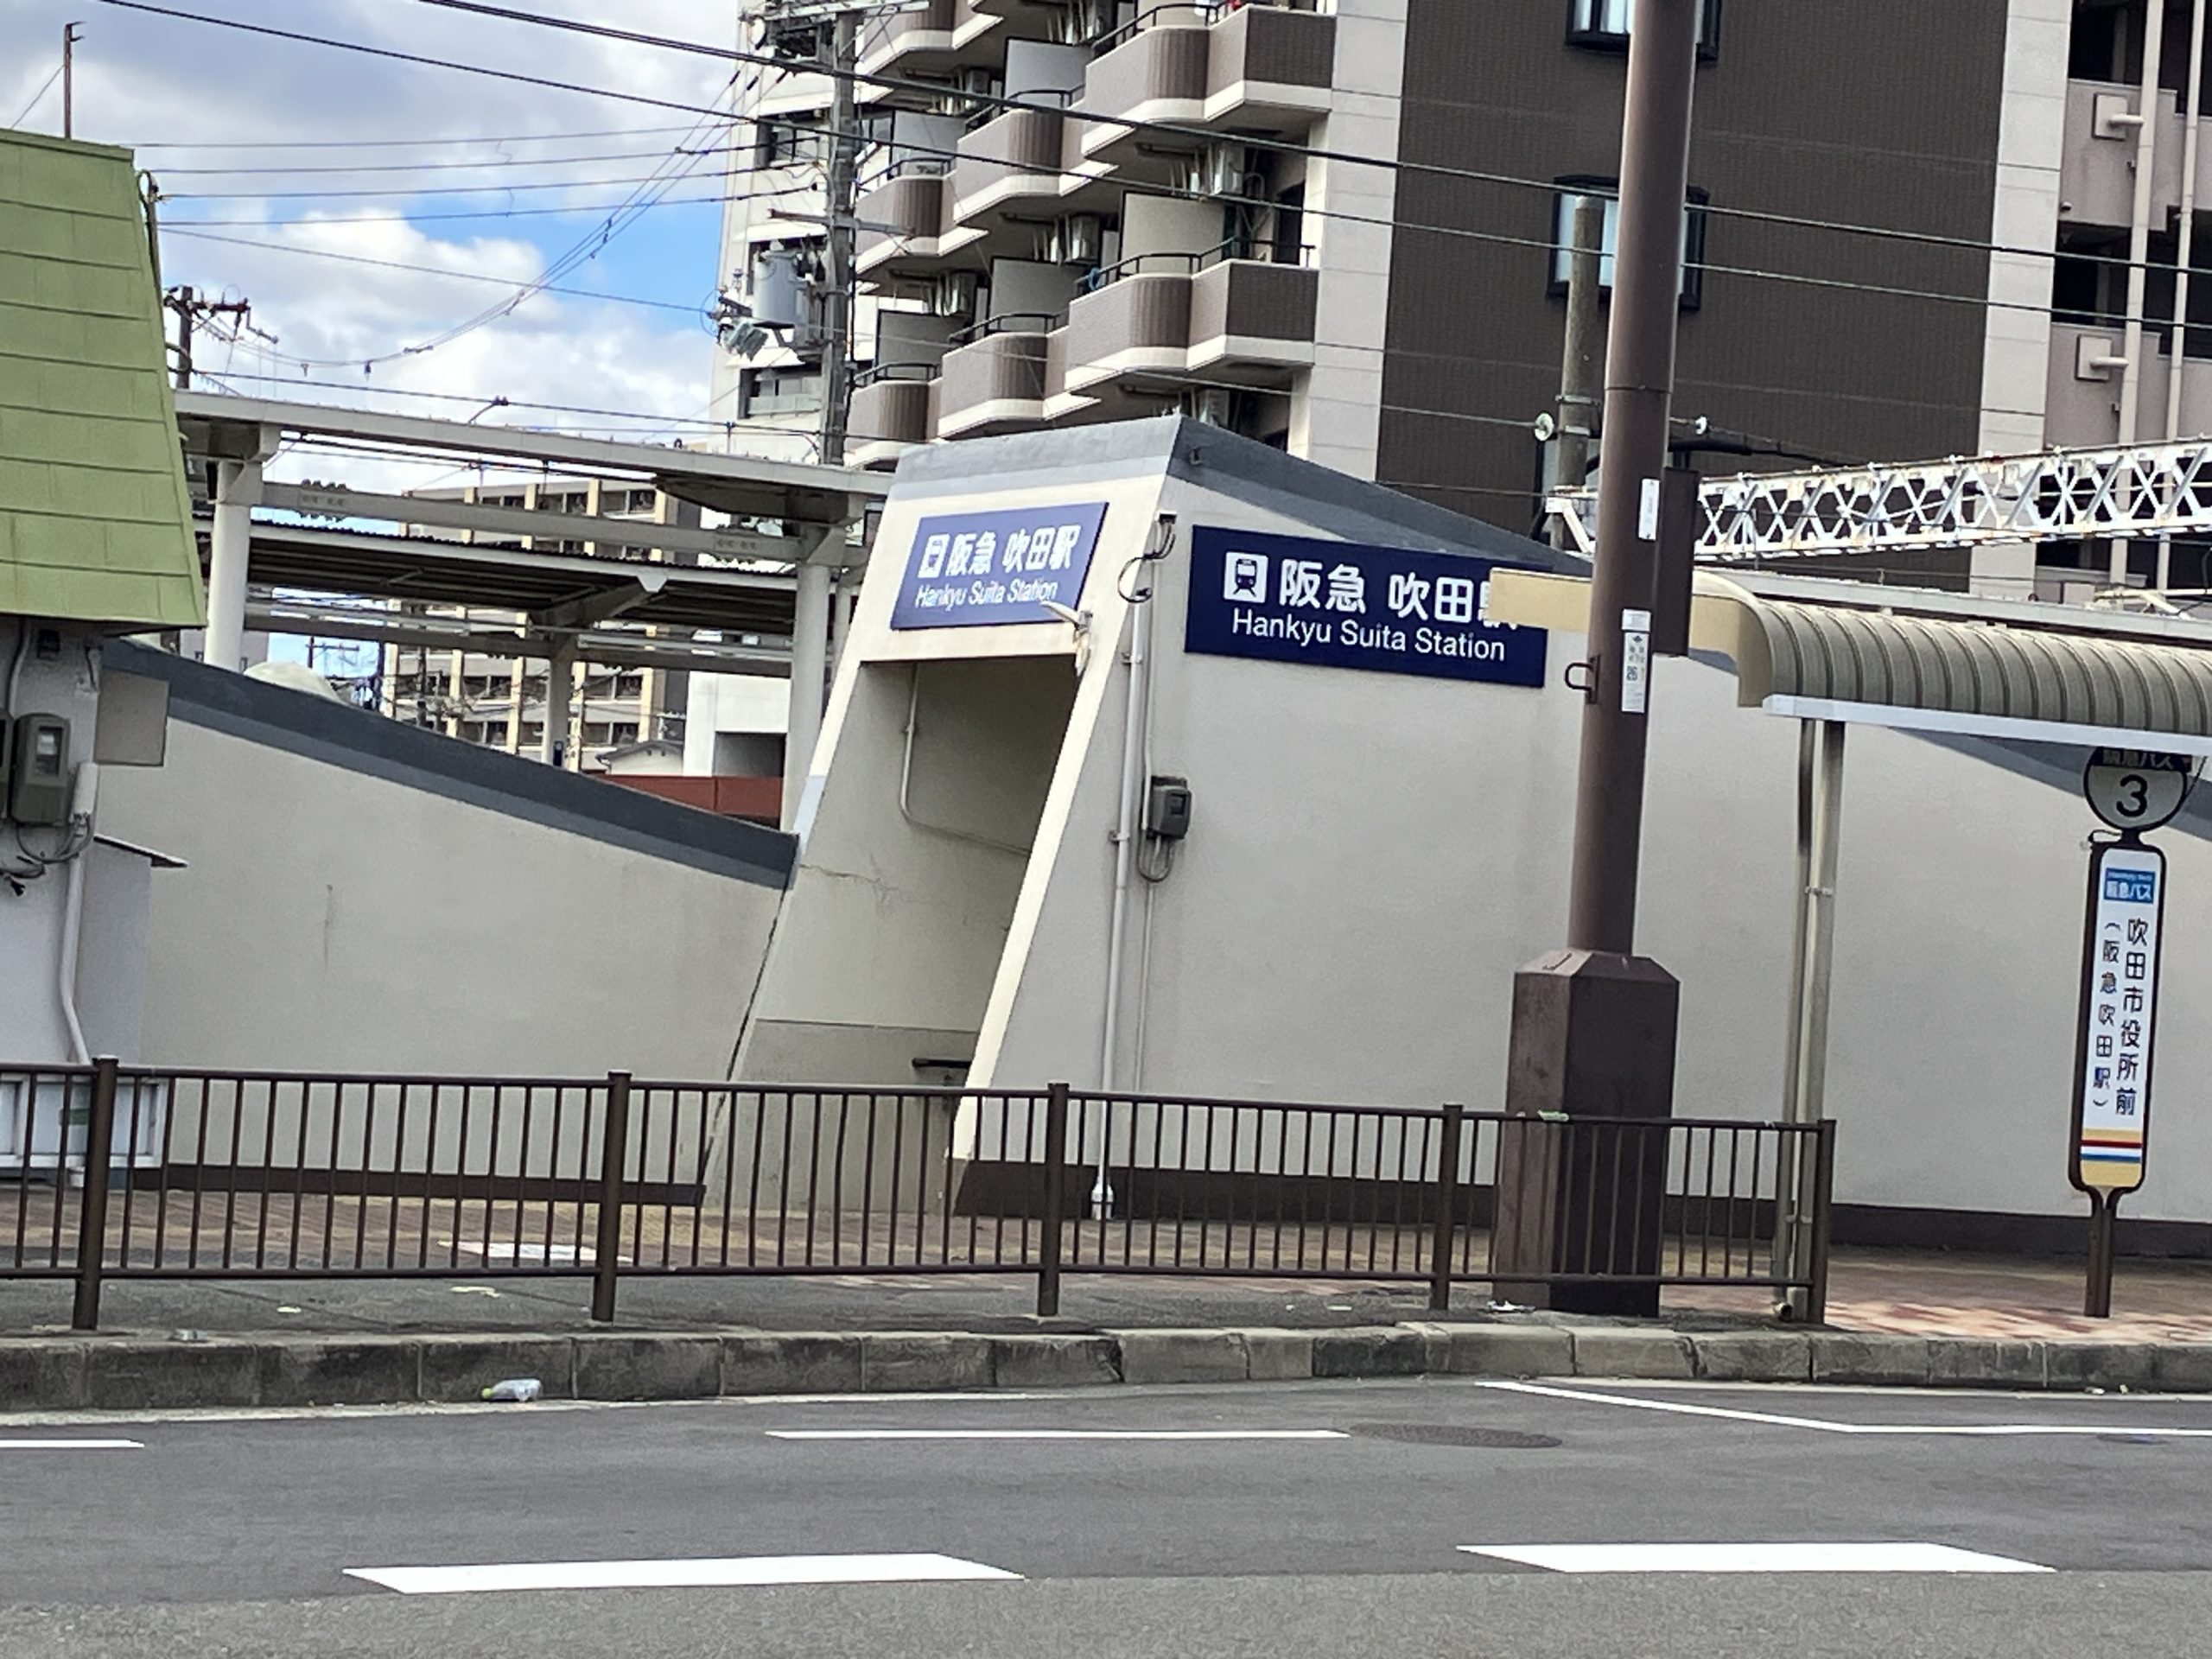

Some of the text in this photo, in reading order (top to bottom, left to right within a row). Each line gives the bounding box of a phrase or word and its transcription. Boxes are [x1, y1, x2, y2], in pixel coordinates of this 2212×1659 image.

[945, 524, 1081, 576] 阪急 吹田駅
[915, 577, 1058, 611] Hankyu Suita Station
[1279, 558, 1518, 629] 阪急 吹田
[1232, 607, 1505, 662] Hankyu Suita Station
[2116, 774, 2148, 817] 3
[2116, 918, 2149, 1116] 吹田市役所前
